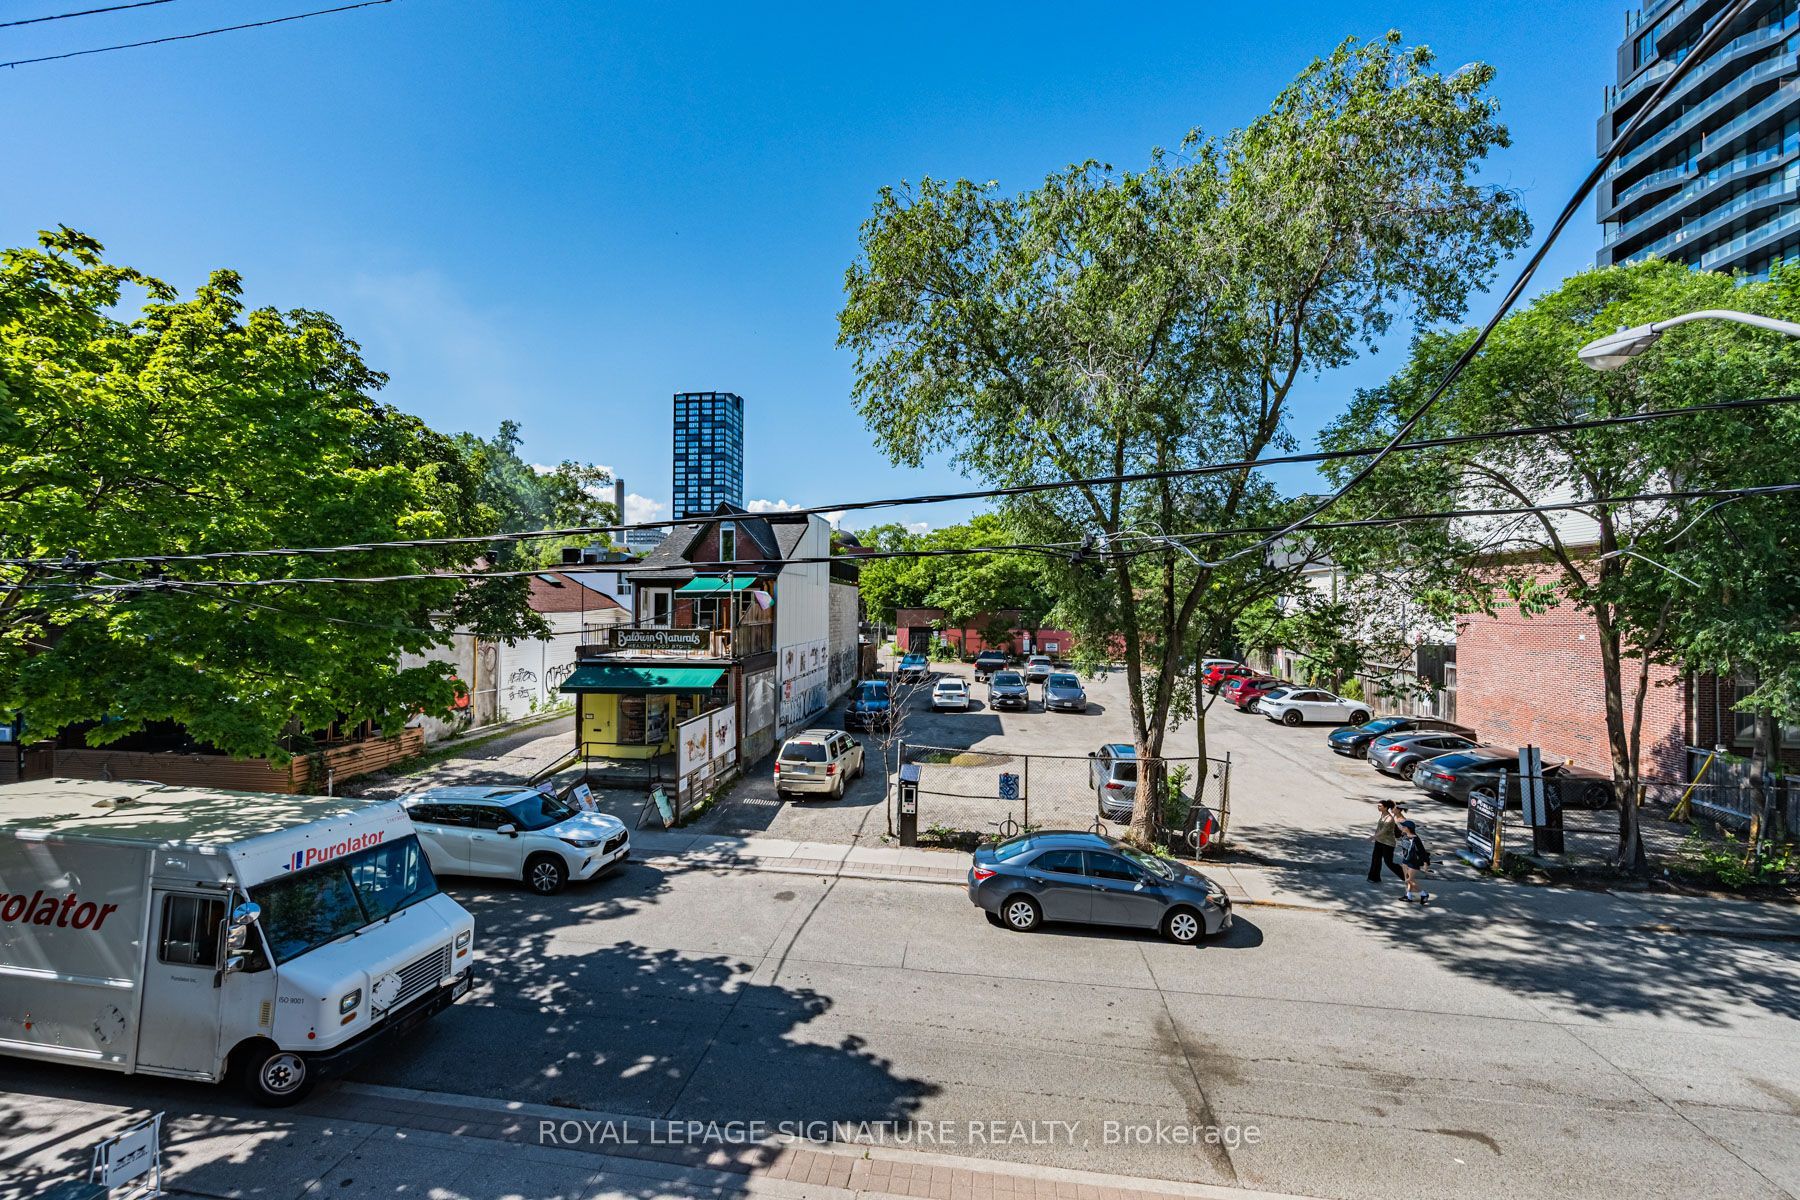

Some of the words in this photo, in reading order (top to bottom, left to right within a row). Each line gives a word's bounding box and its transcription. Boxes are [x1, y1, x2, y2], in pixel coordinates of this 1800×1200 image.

[618, 631, 655, 647] Baldwin
[656, 631, 700, 644] Naturals
[305, 830, 385, 867] Purolator
